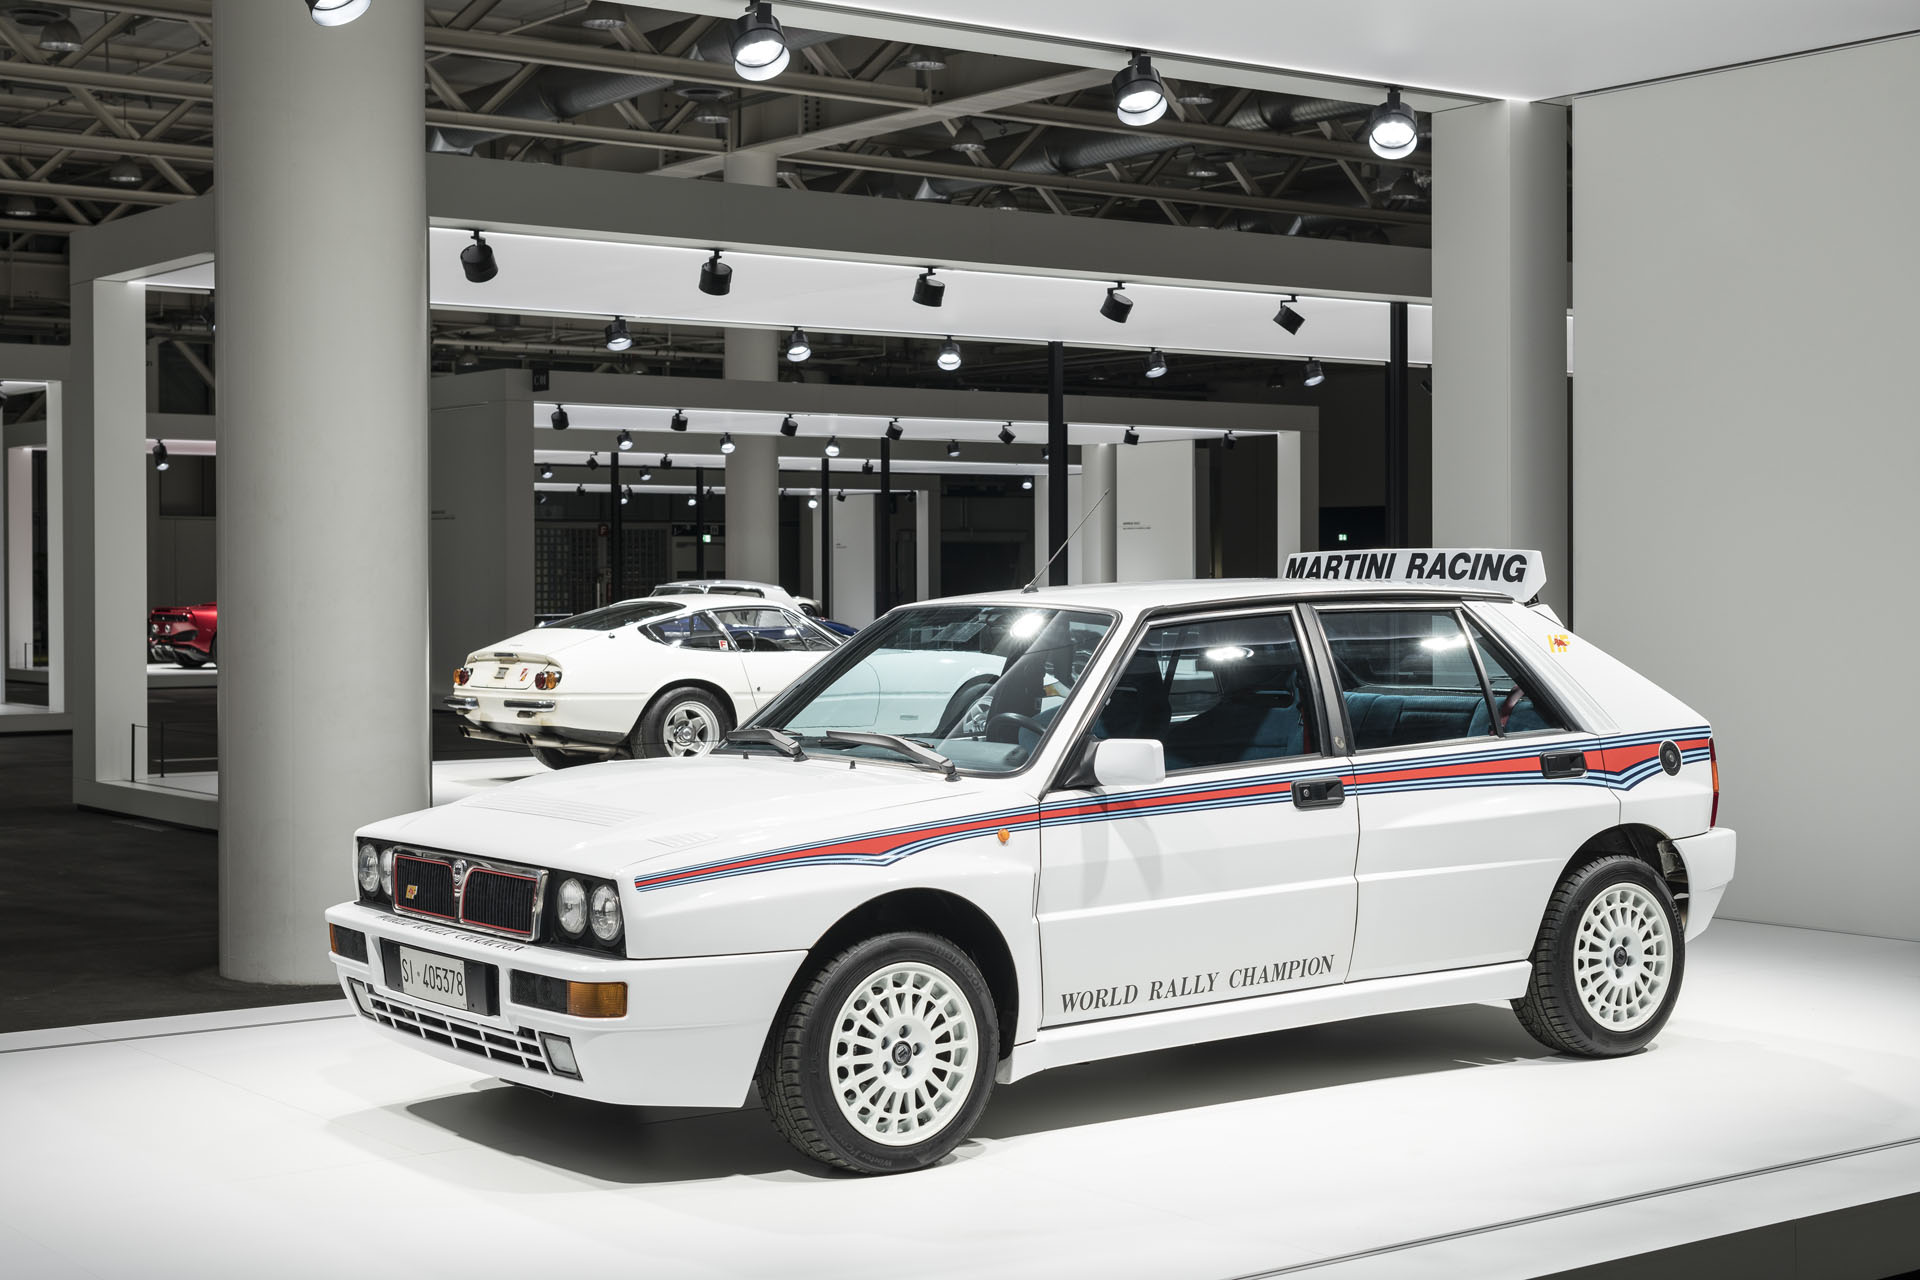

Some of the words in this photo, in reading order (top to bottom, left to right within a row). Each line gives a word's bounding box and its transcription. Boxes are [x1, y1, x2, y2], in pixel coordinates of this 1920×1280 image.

[1285, 553, 1397, 579] MARTINI
[1405, 552, 1528, 583] RACING
[1061, 984, 1139, 1013] WORLD
[1149, 971, 1220, 1001] RALLY
[1229, 954, 1335, 989] CHAMPION
